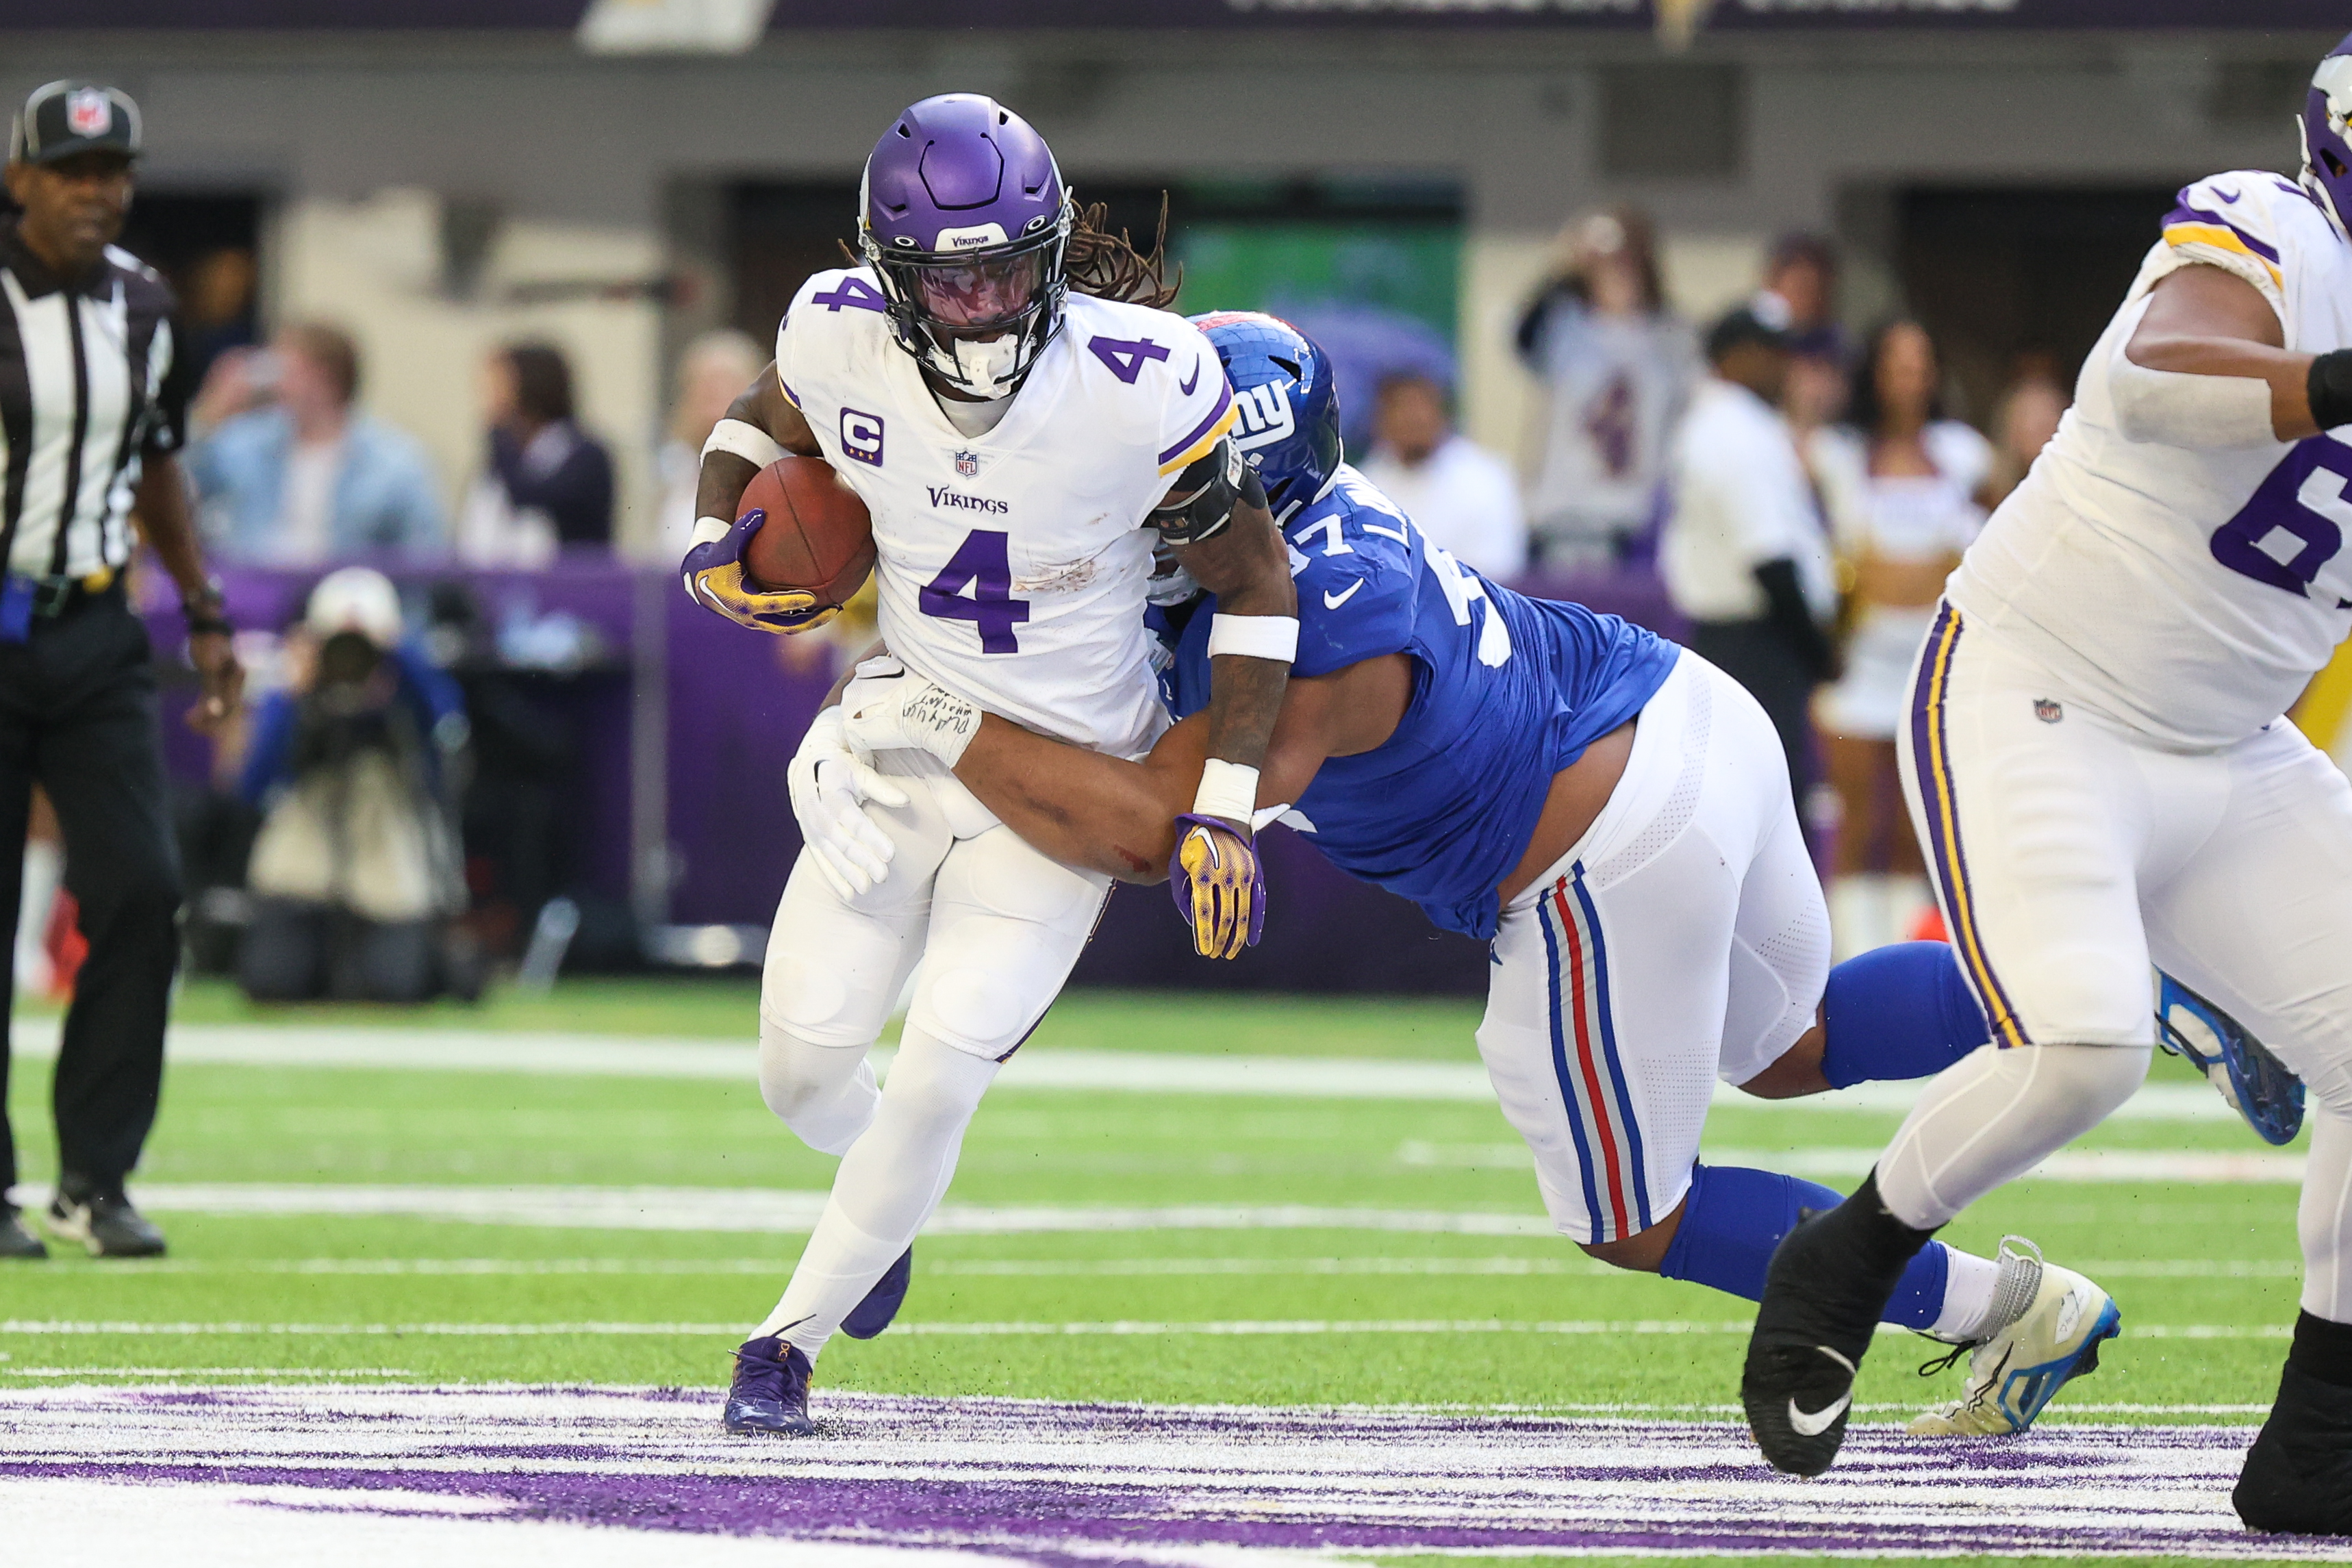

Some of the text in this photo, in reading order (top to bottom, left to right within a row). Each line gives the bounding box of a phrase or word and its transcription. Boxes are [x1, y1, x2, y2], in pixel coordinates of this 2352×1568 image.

[811, 276, 886, 314] 4
[1087, 335, 1171, 385] 4
[843, 412, 881, 453] C
[958, 461, 976, 474] NFL
[2210, 431, 2352, 609] 6
[919, 529, 1030, 654] 4
